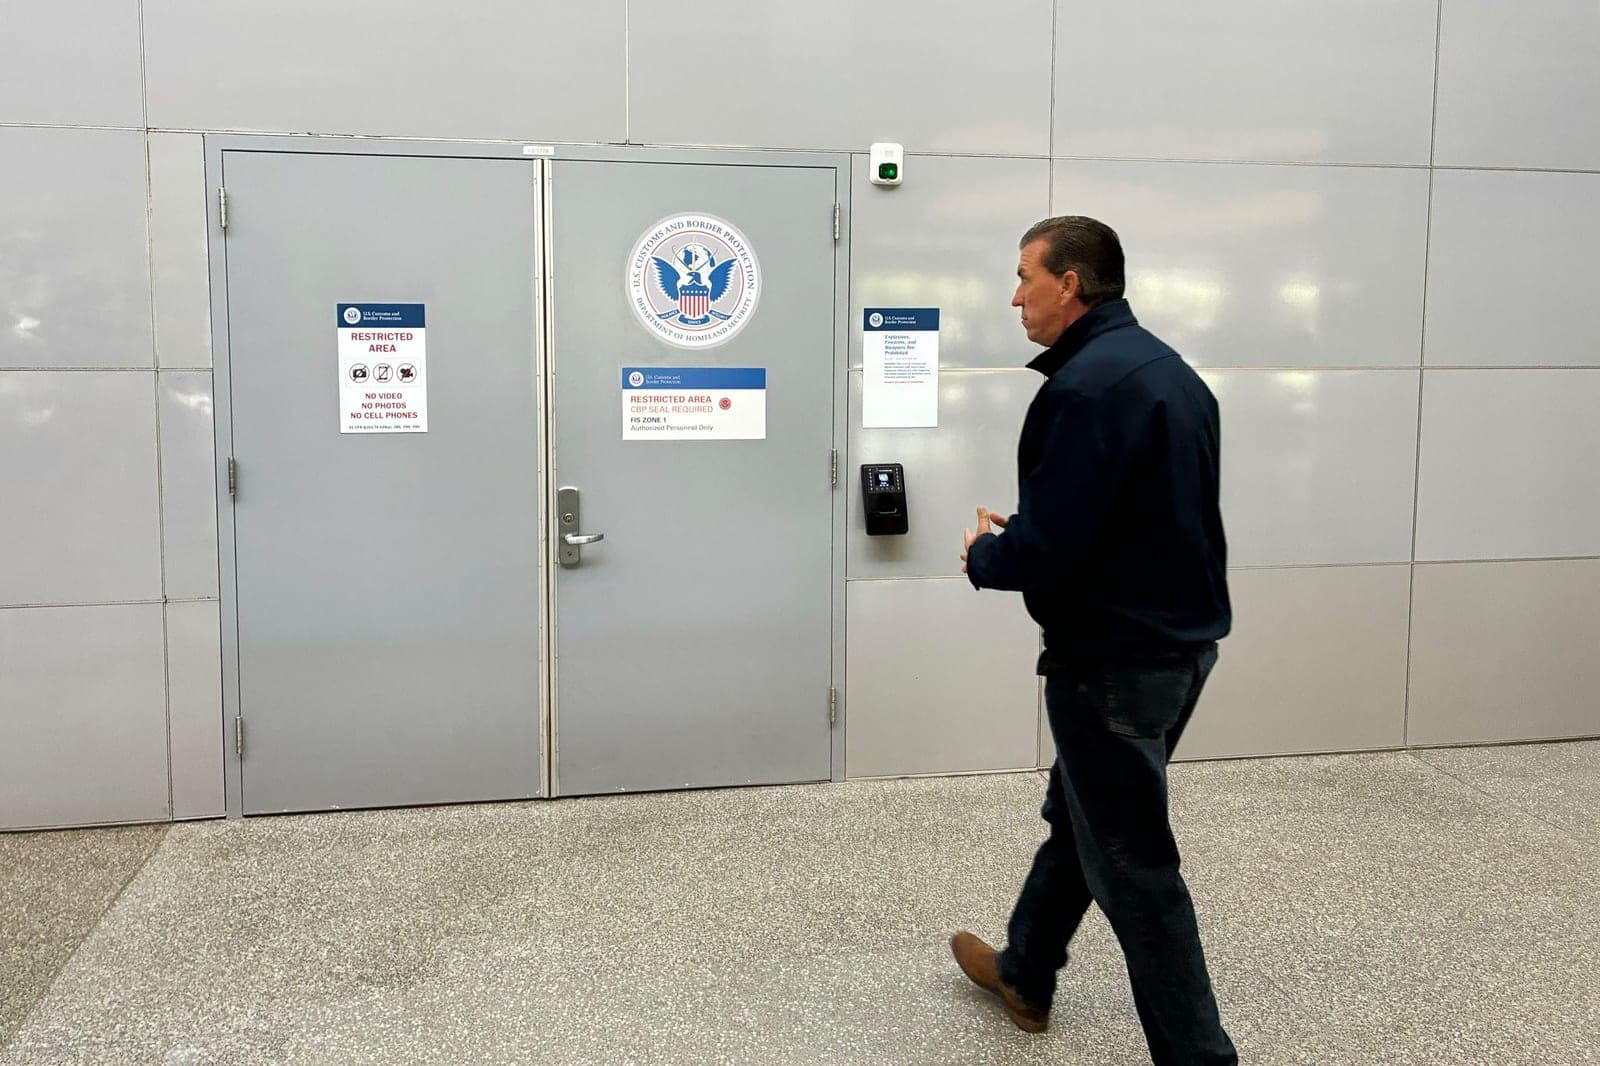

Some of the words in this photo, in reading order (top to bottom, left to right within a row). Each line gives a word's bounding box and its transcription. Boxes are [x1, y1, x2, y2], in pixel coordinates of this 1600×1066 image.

[665, 220, 685, 235] AND
[686, 220, 723, 235] BORDER
[634, 230, 665, 268] CUSTOMS
[723, 231, 755, 290] PROTECTION
[633, 271, 641, 288] U.S.
[636, 297, 674, 336] DEPARTMENT
[673, 332, 684, 340] OF
[685, 326, 729, 342] HOMELAND
[727, 298, 752, 330] SECURITY
[351, 332, 414, 341] RESTRICTED
[368, 344, 397, 352] AREA
[630, 396, 686, 404] RESTRICTED
